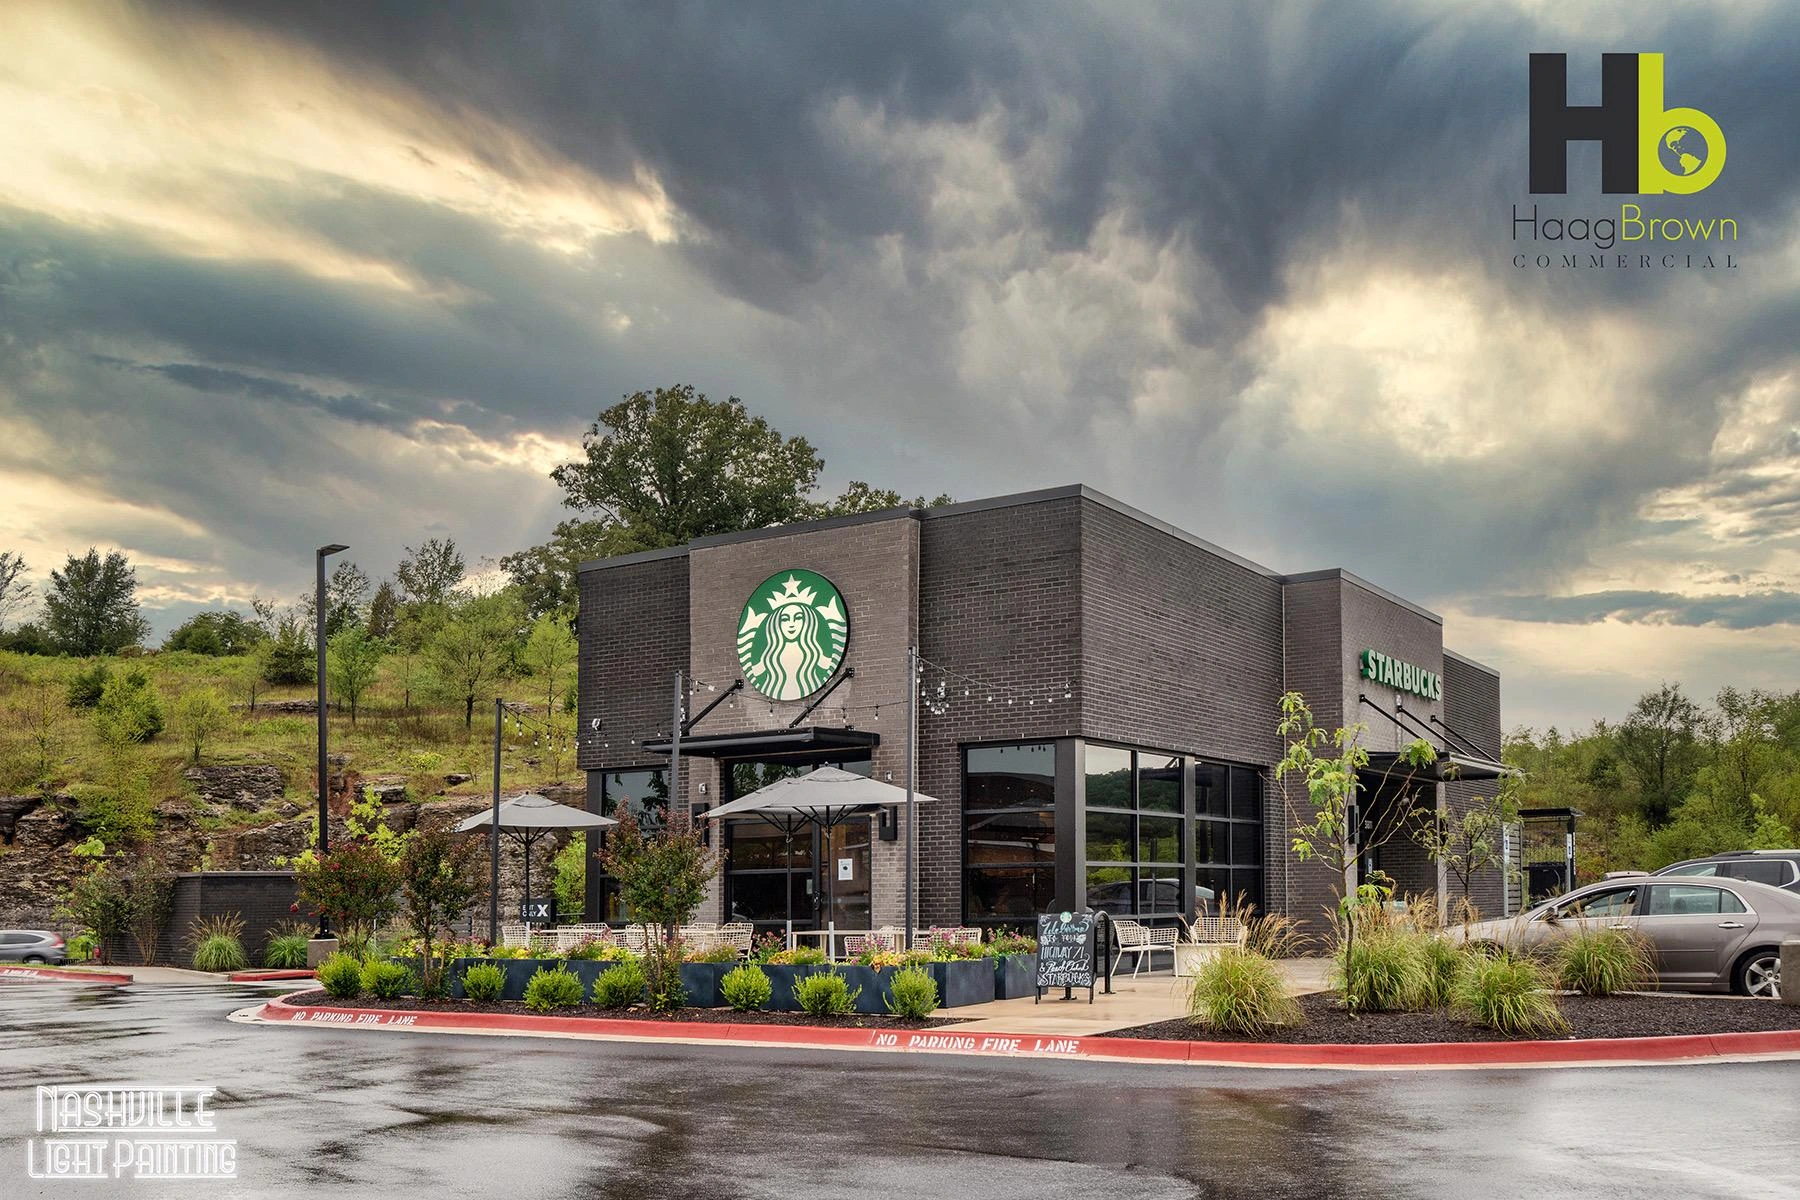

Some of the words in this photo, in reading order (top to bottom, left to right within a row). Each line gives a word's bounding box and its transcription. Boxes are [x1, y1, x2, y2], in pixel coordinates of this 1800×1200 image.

[1366, 649, 1442, 701] STARBUCKS
[1038, 972, 1091, 987] STARBUCKS
[291, 1011, 307, 1021] NO
[310, 1012, 354, 1024] PARKING
[355, 1013, 383, 1025] FIRE
[386, 1015, 418, 1026] LANE
[875, 1033, 898, 1046] NO
[908, 1035, 976, 1050] PARKING
[980, 1037, 1022, 1052] FIRE
[1033, 1039, 1080, 1054] LANE
